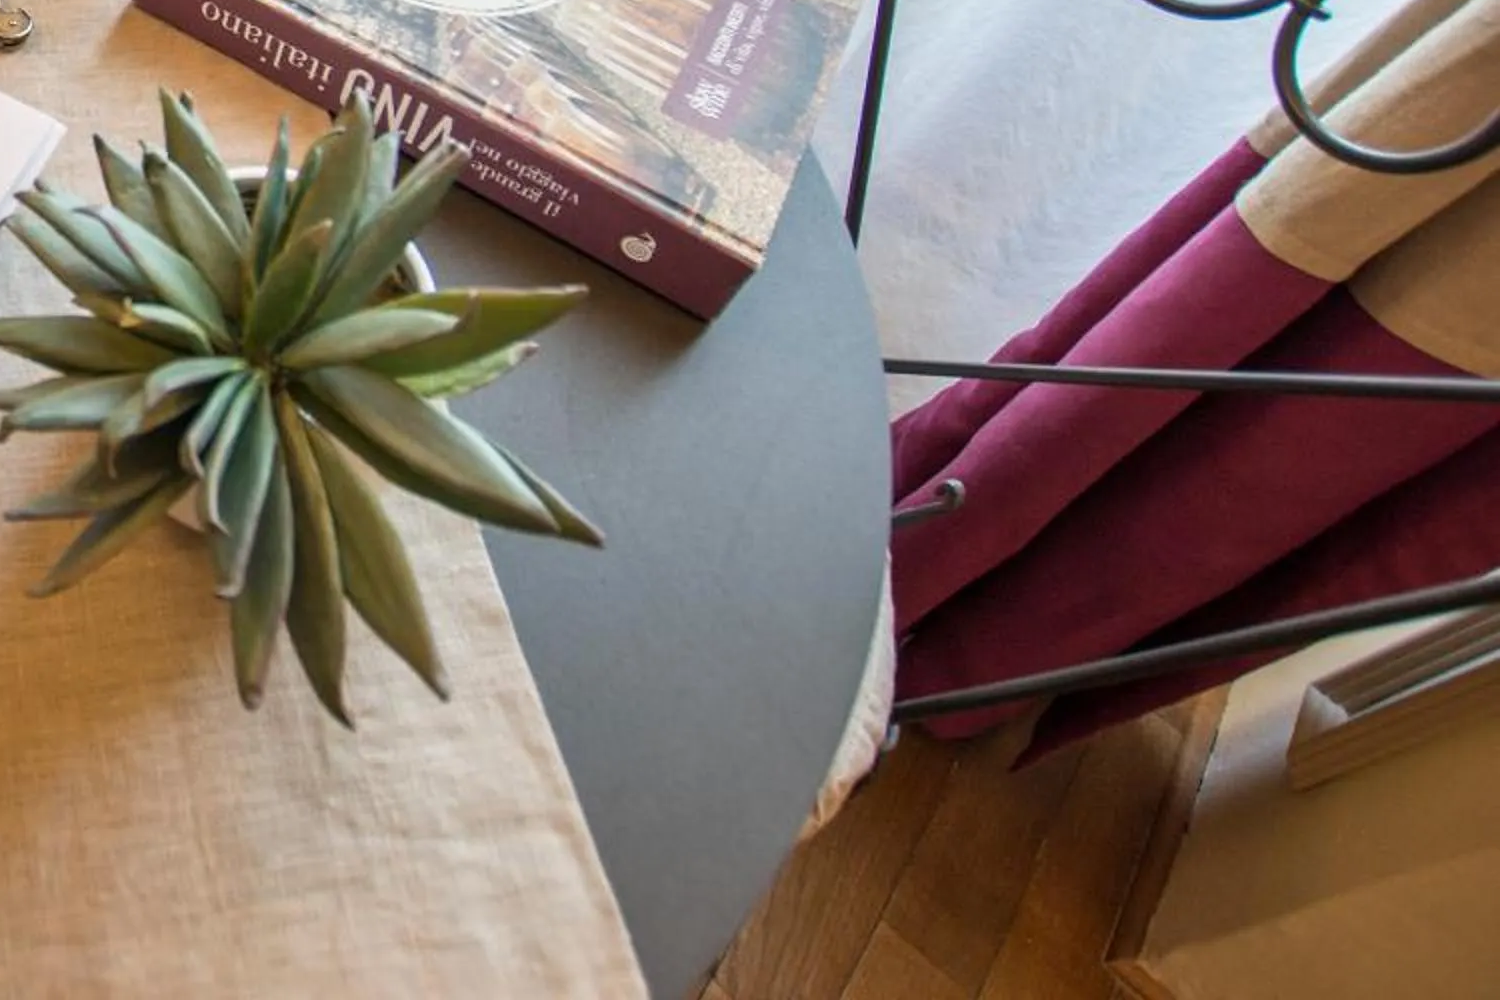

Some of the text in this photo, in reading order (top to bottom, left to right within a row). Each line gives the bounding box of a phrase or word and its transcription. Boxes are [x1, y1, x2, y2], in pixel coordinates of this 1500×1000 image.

[201, 1, 335, 92] italiano
[468, 137, 580, 206] viaggio nel
[470, 159, 562, 217] il grande
